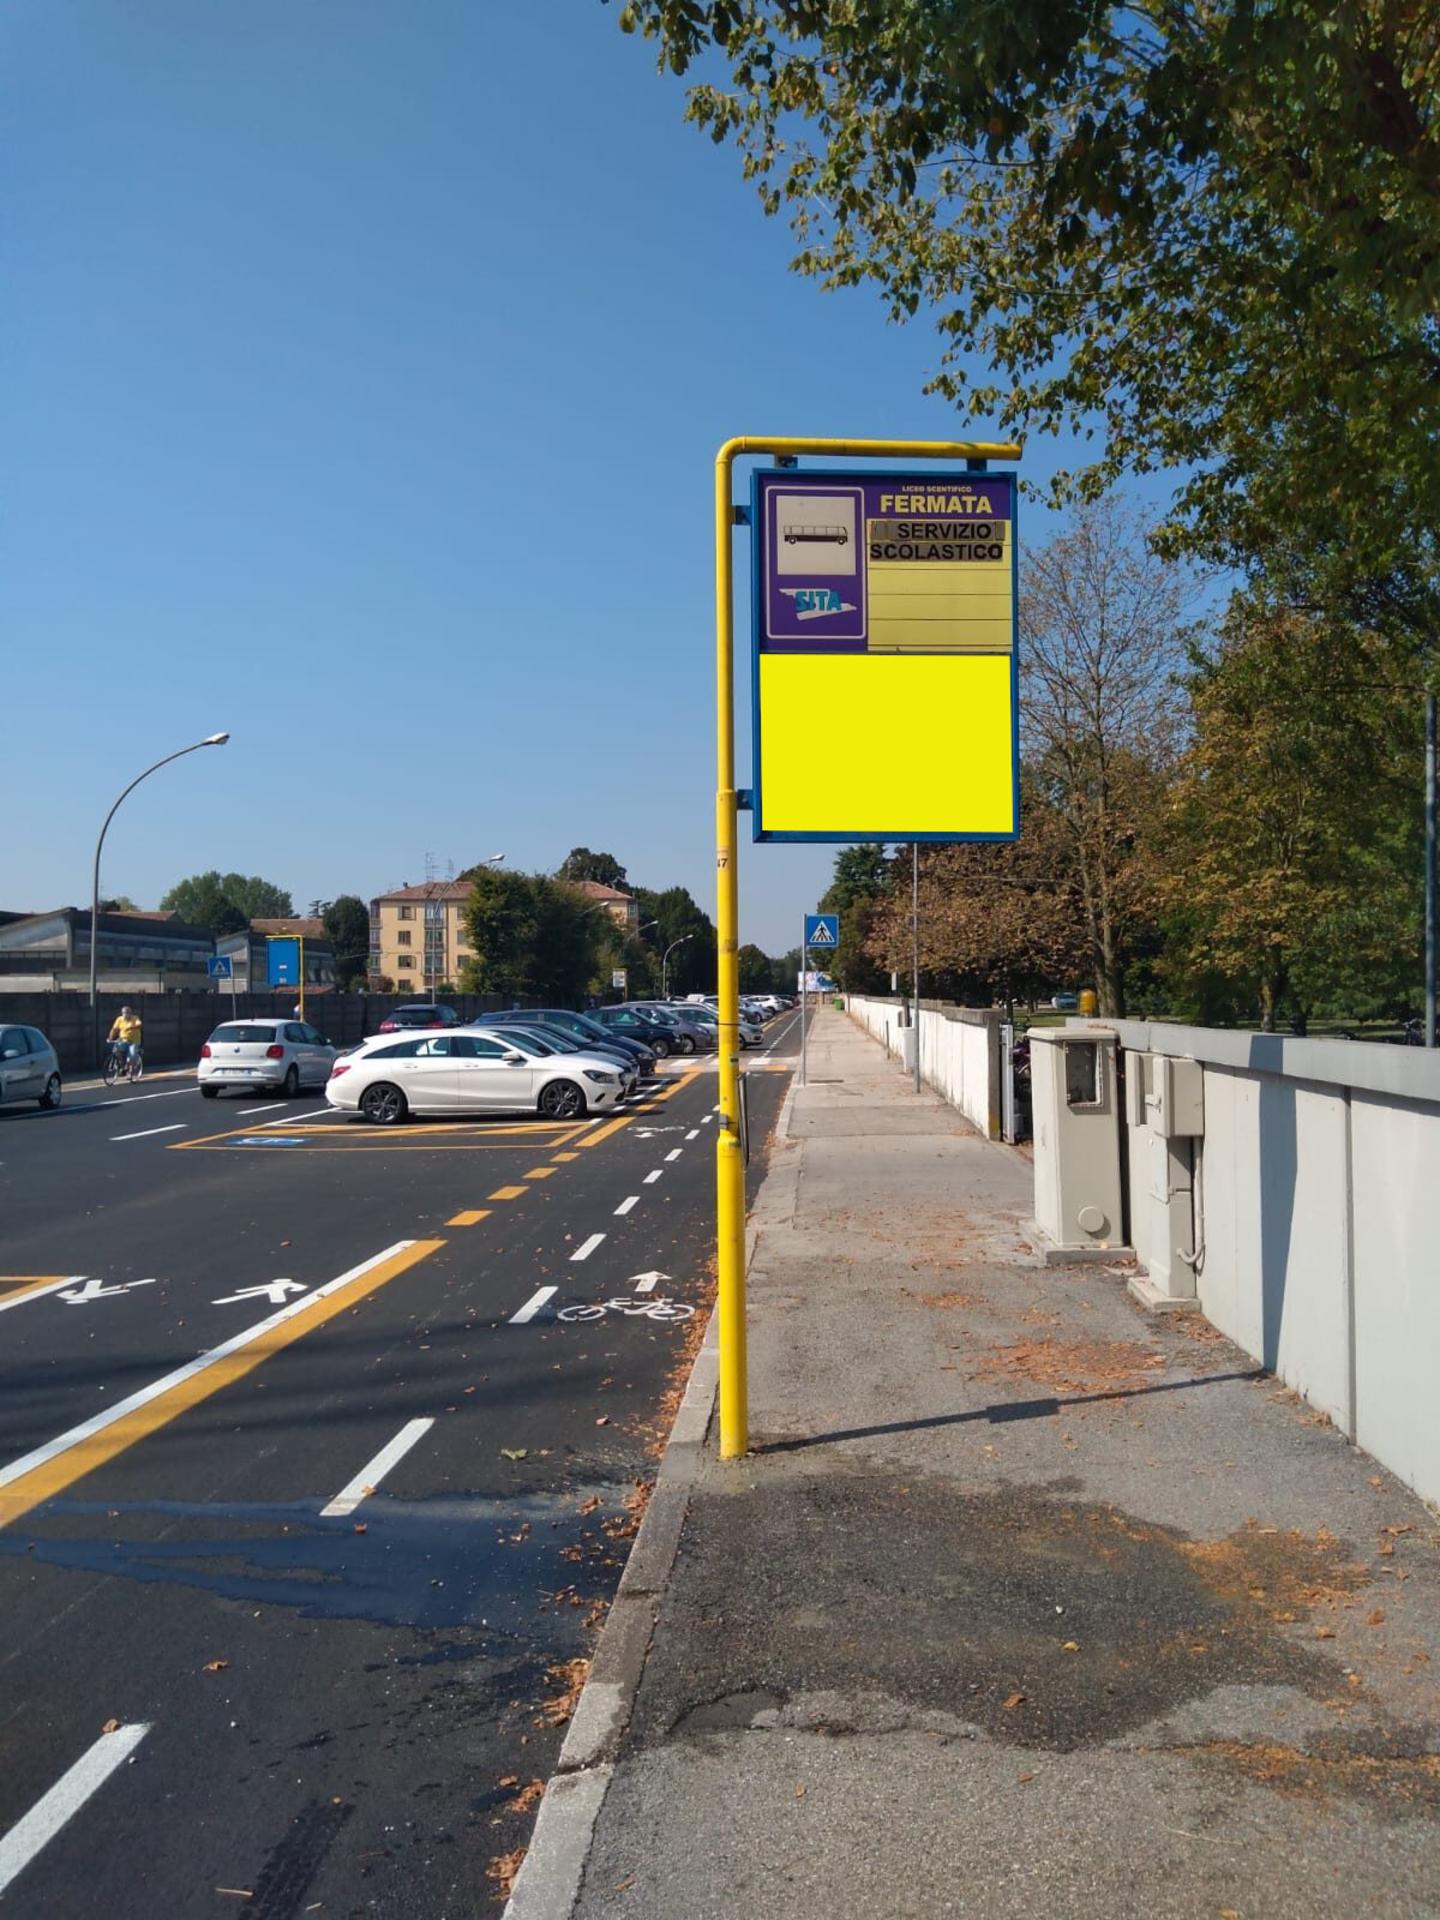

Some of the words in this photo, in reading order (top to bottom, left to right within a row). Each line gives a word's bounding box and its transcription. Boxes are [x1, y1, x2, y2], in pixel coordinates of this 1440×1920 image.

[880, 495, 992, 513] FERMATA
[897, 523, 992, 539] SERVIZIO
[870, 544, 1002, 560] SCOLASTICO
[795, 591, 842, 611] SITA
